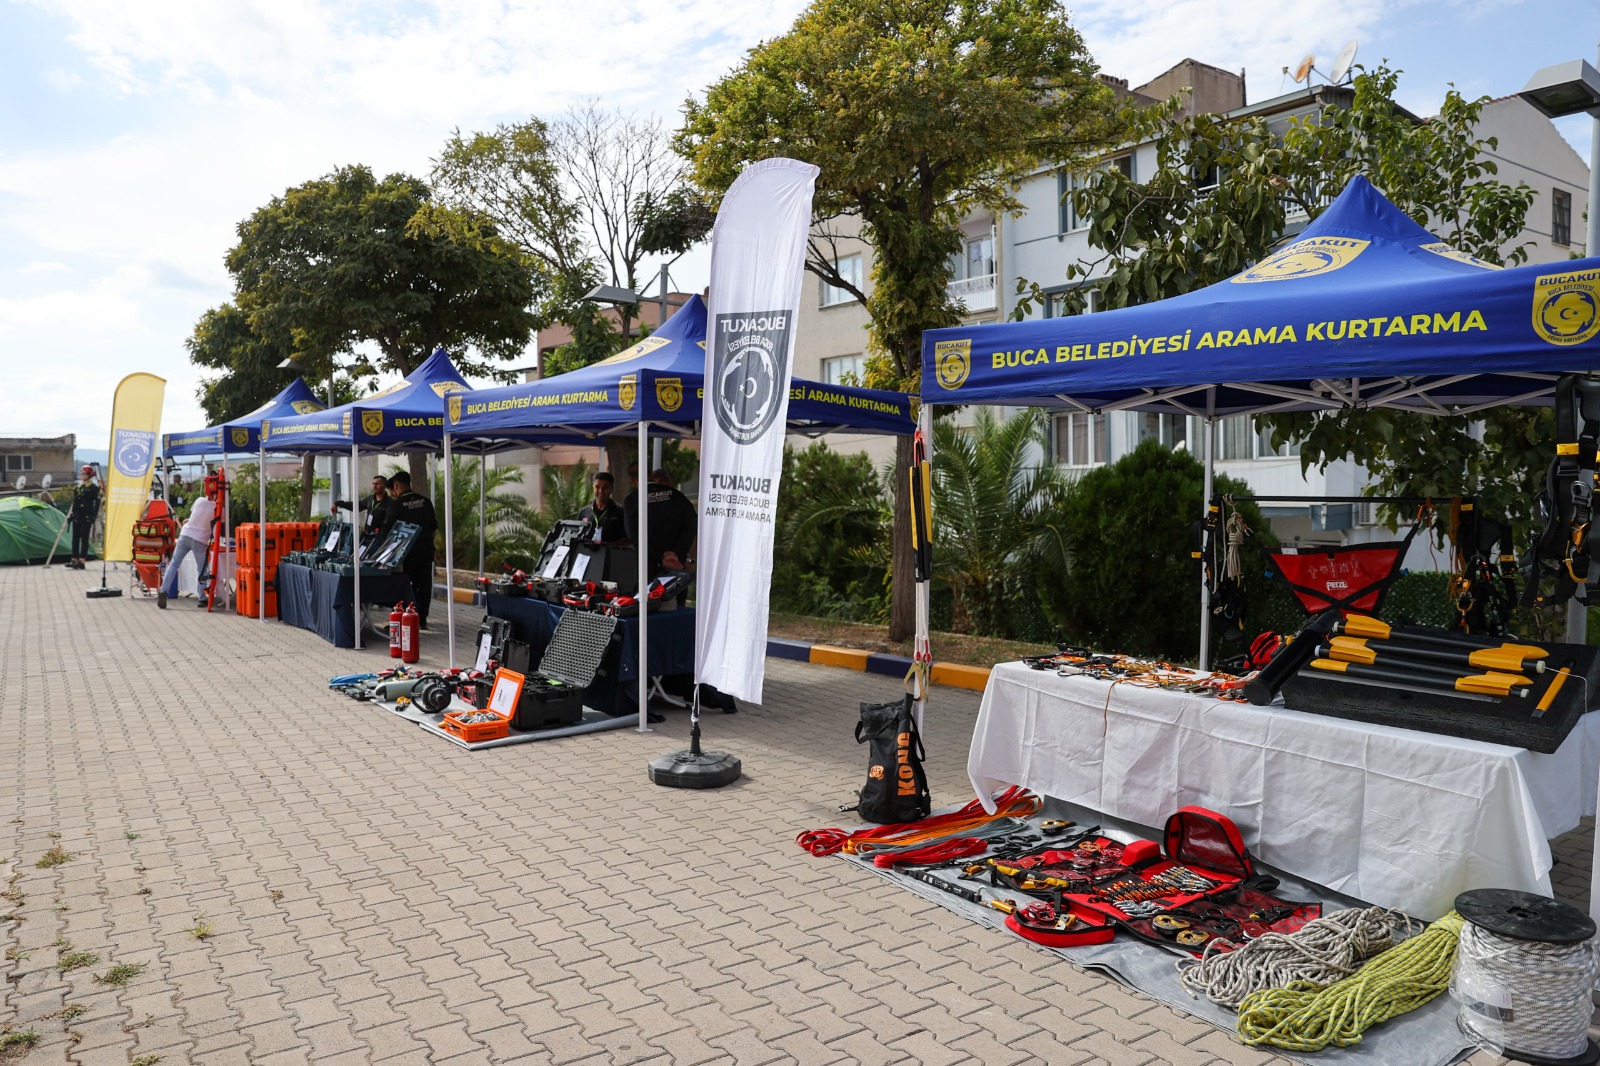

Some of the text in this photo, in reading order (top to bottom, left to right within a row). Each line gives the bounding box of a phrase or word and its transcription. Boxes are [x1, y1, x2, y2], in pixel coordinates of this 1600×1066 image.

[992, 310, 1488, 369] BUCA BELEDİYESİ ARAMA KURTARMA
[467, 390, 609, 415] BUCA BELEDİYESİ ARAMA KURTARMA
[808, 389, 847, 406] ARAMA
[848, 396, 901, 415] KURTARMA
[395, 418, 426, 427] BUCA
[1326, 580, 1348, 591] PETZL
